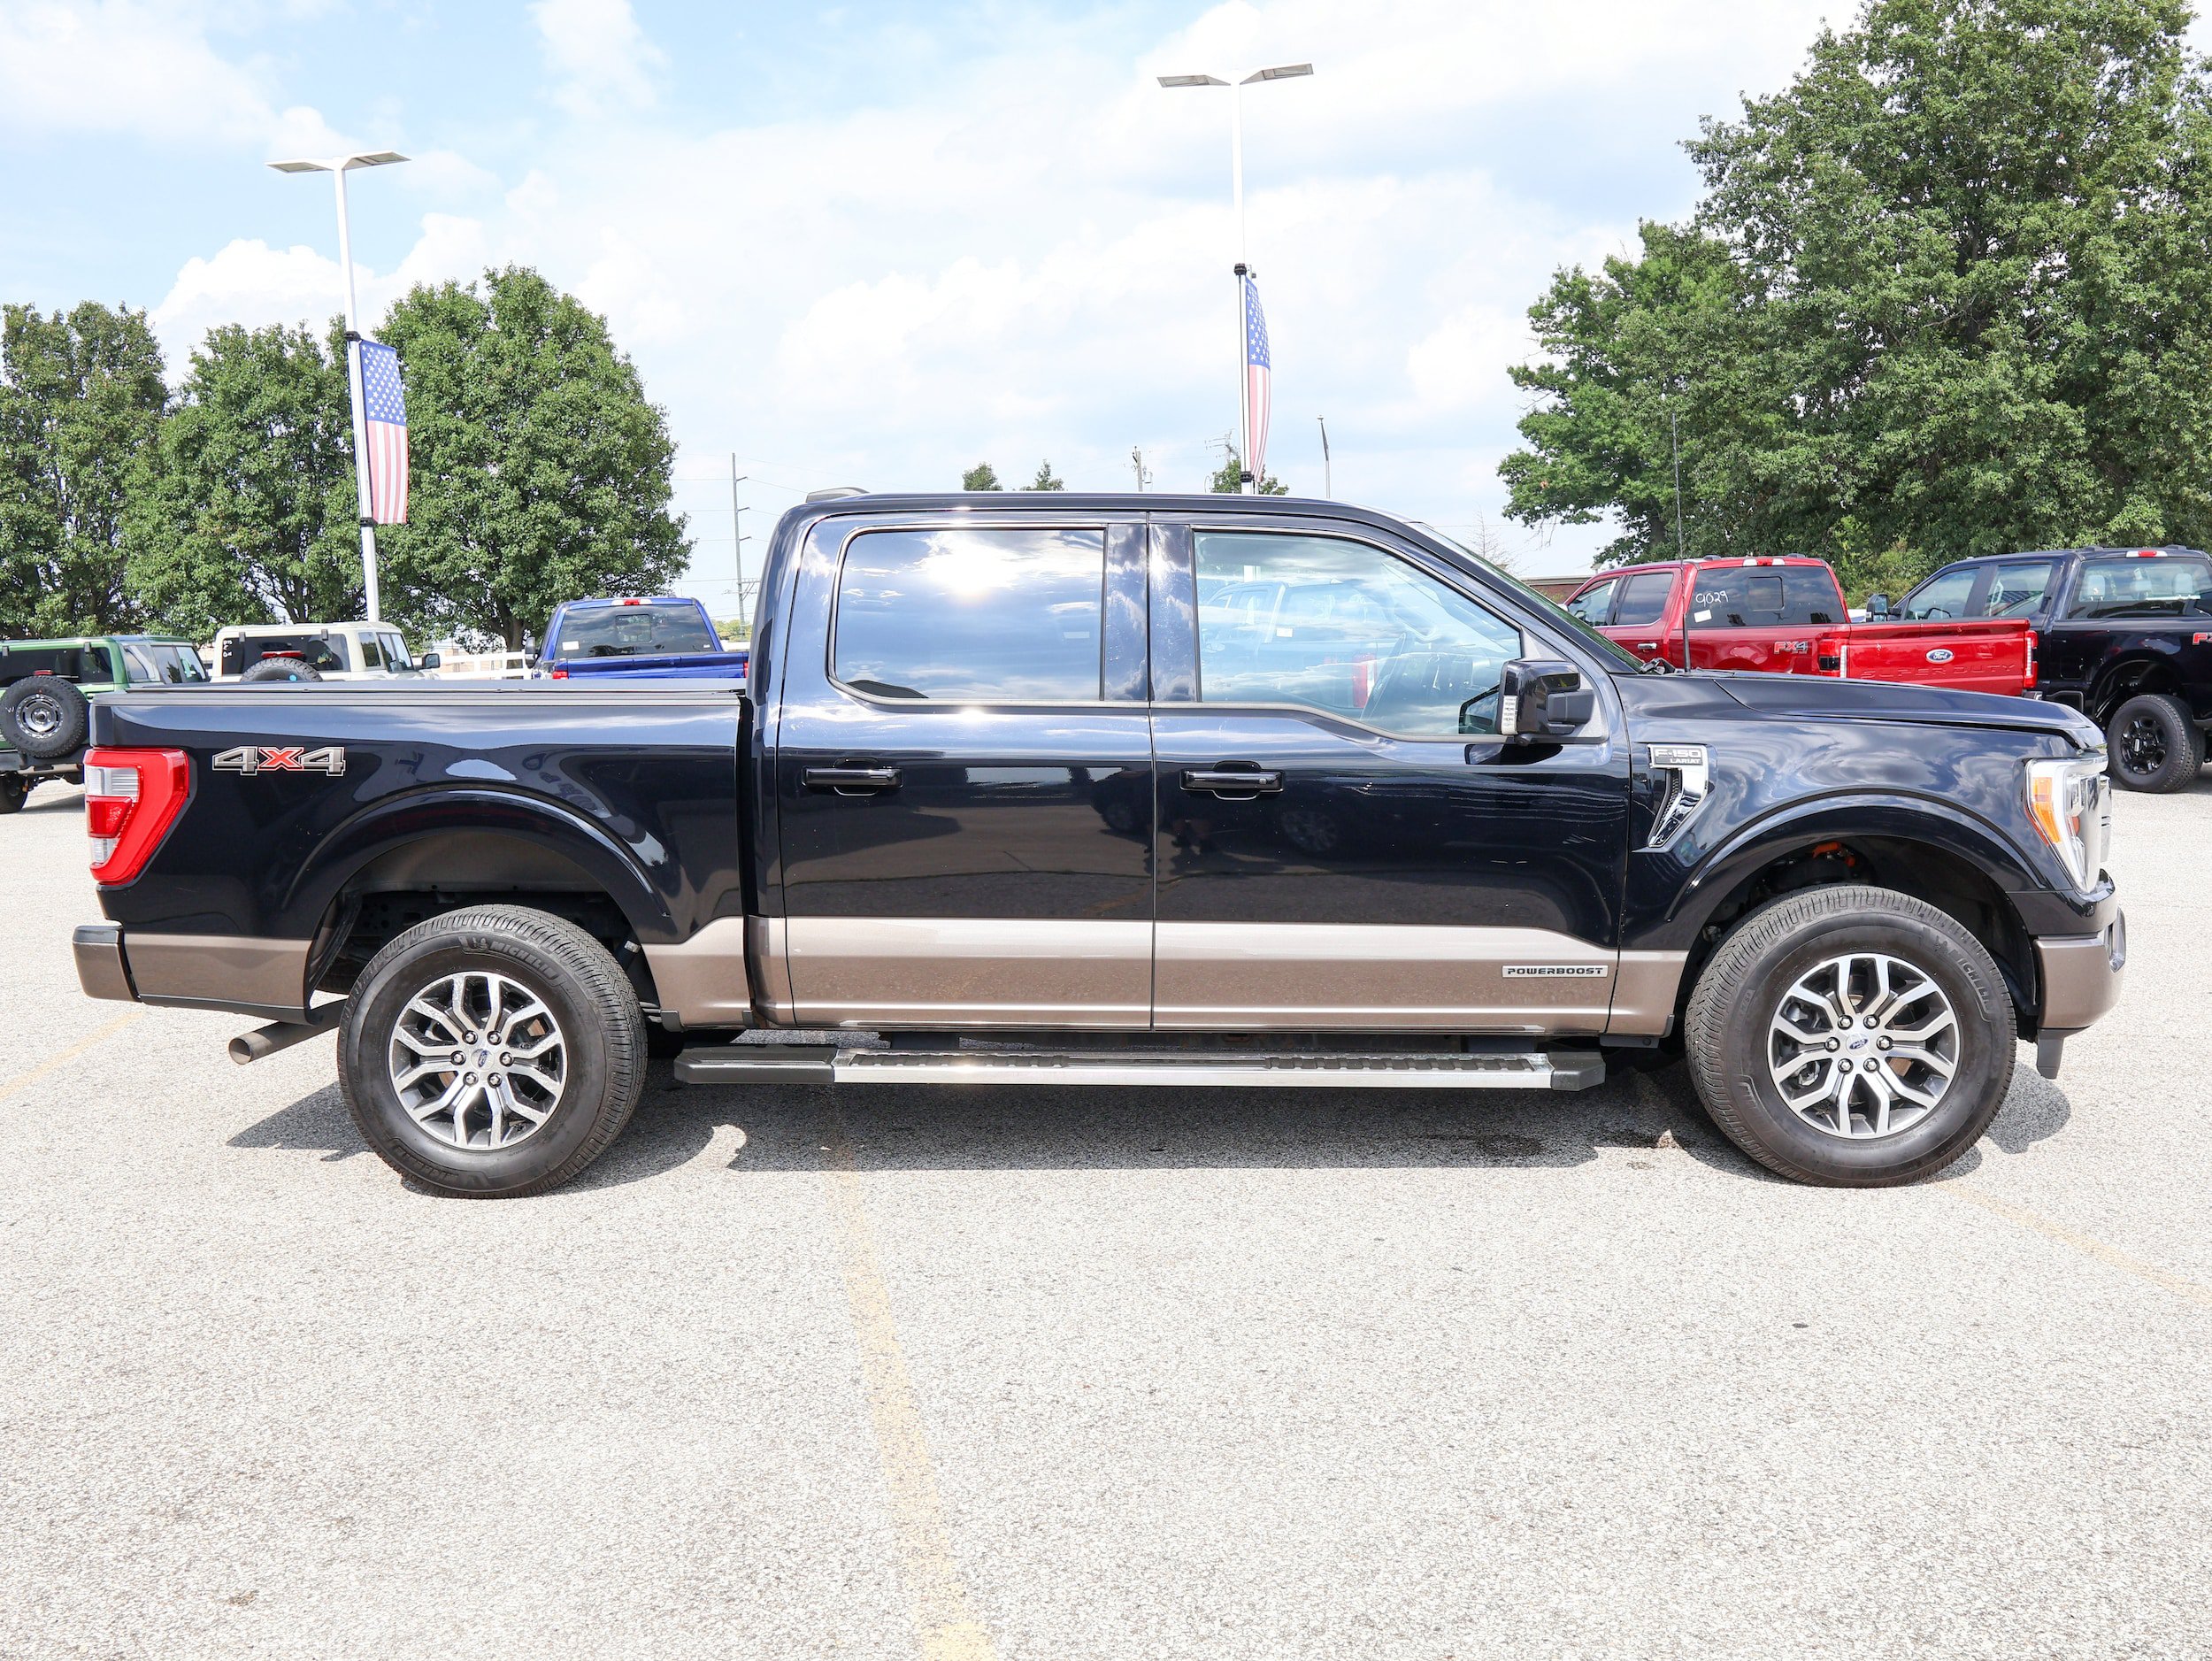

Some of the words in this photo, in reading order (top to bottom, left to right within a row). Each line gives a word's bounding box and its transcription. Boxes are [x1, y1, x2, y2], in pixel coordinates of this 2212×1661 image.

[1695, 590, 1729, 607] 9029
[1774, 641, 1808, 654] FX4
[1861, 667, 1946, 679] SUPER
[1954, 665, 2015, 674] DUTY
[1655, 749, 1701, 758] F-150
[489, 941, 555, 979] MICHELIN
